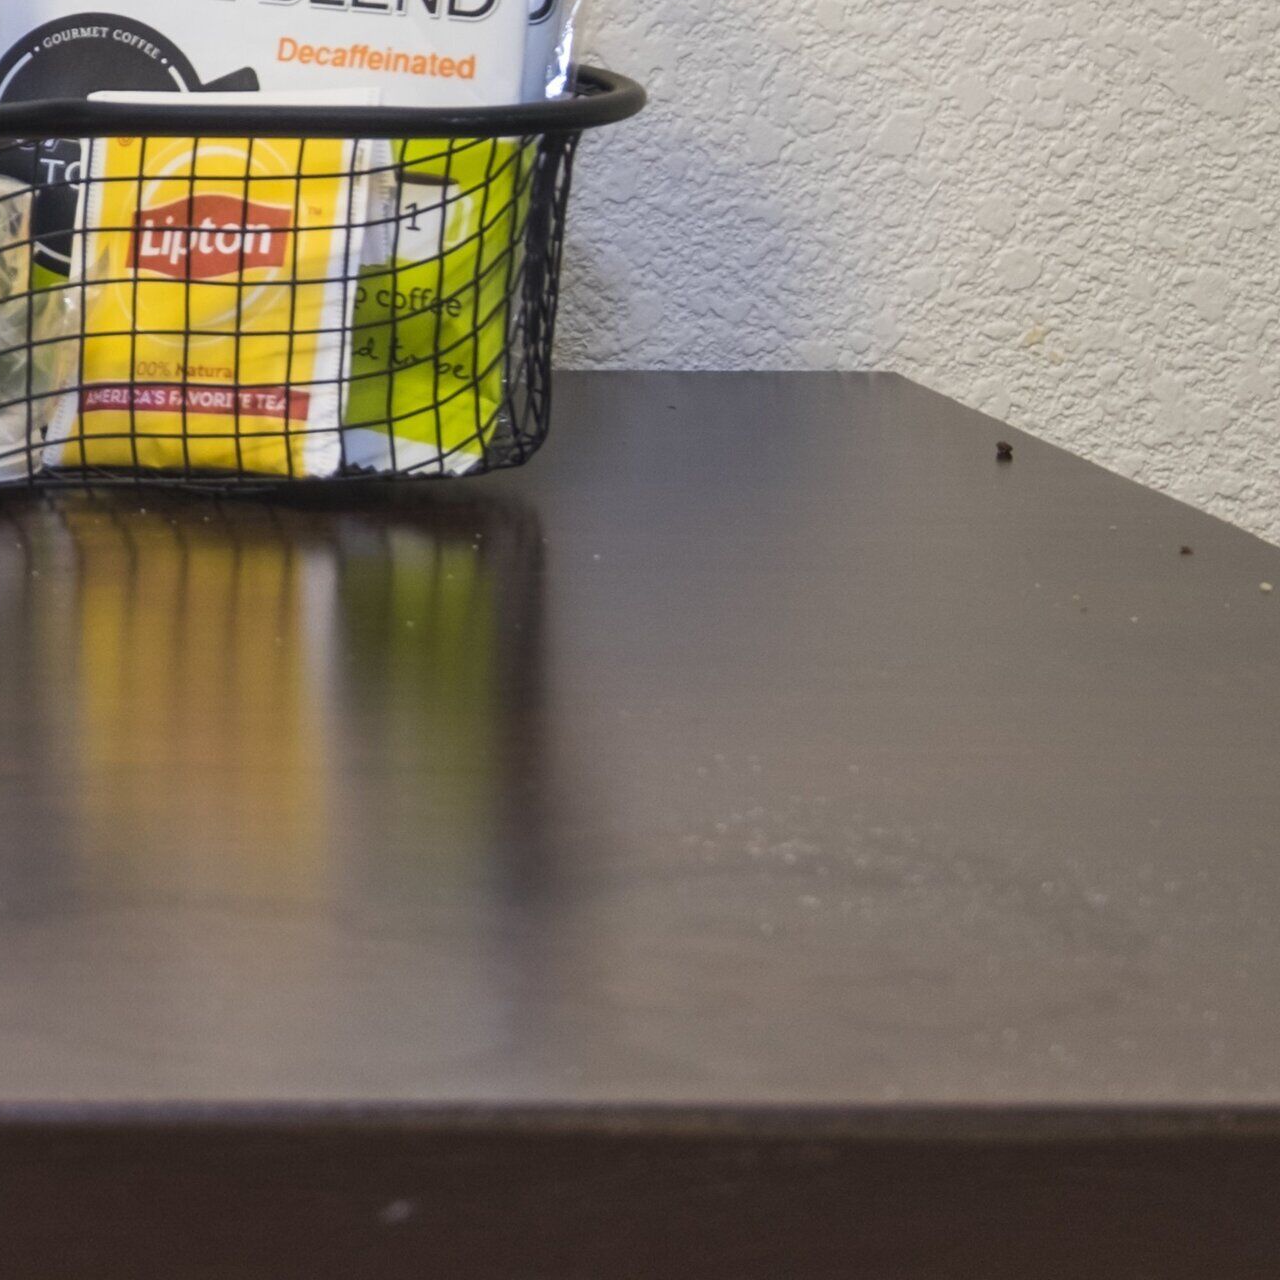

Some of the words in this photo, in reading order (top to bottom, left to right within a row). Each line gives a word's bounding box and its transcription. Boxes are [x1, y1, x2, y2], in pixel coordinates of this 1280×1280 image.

[42, 26, 109, 49] GOURMET
[112, 28, 161, 60] COFFEE
[277, 37, 476, 81] Decaffeinated
[404, 202, 421, 232] 1
[141, 215, 272, 265] Lipton
[136, 361, 171, 377] 00%
[175, 363, 233, 378] Natura
[169, 389, 251, 409] FVORIE
